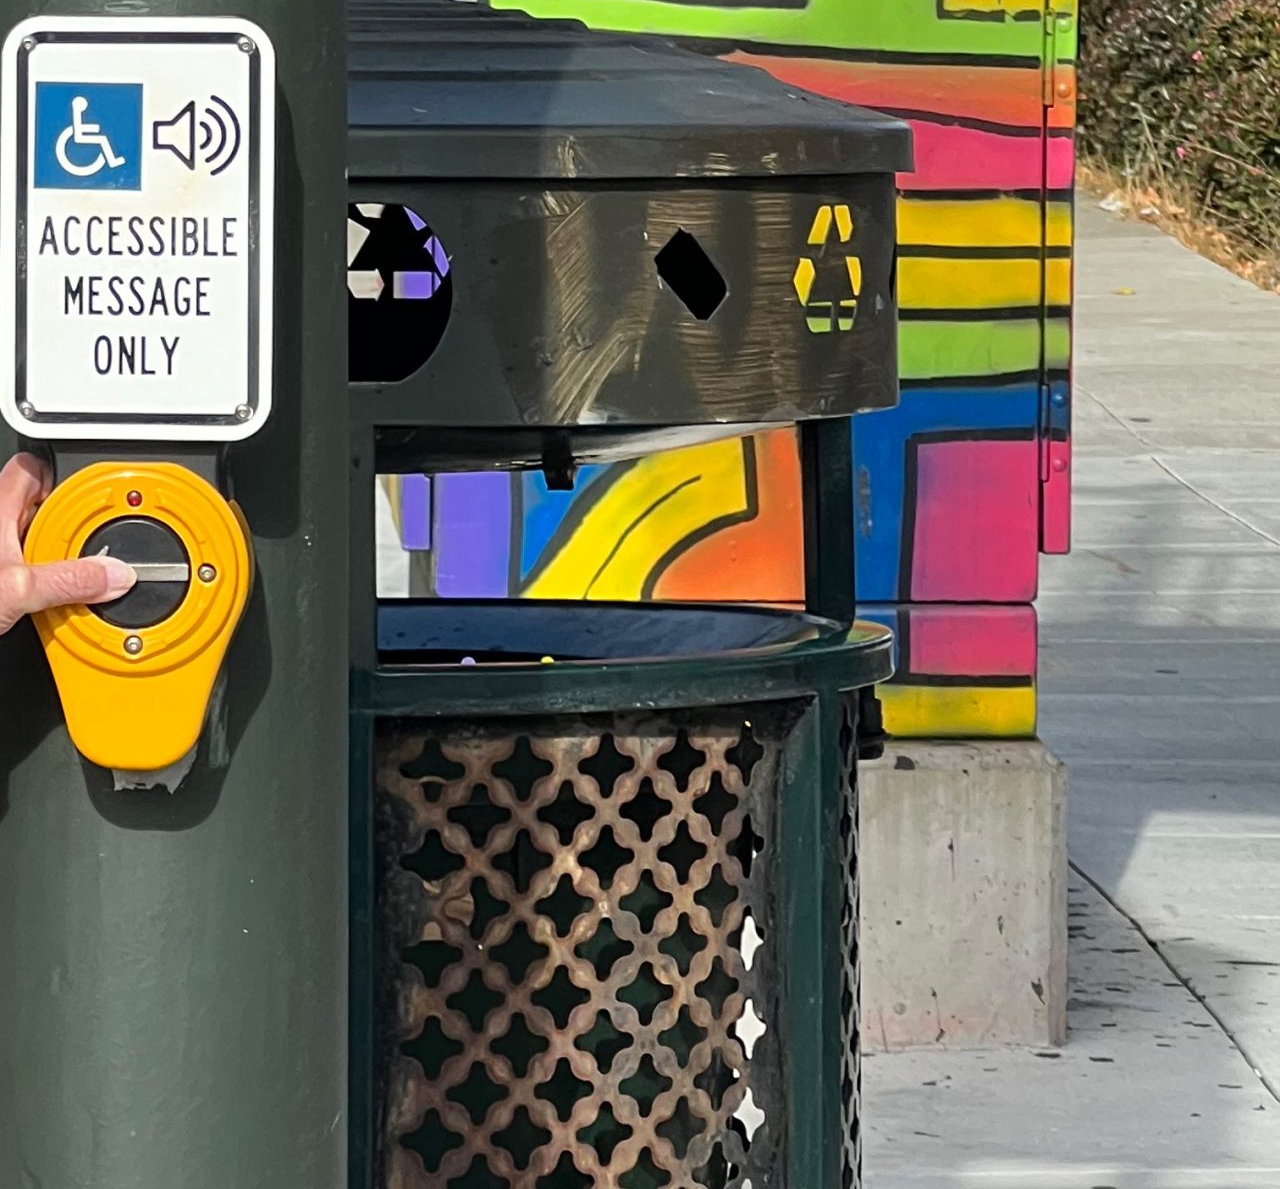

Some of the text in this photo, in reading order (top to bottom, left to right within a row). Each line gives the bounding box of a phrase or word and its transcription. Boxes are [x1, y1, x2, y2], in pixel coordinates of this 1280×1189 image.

[38, 215, 239, 257] ACCESSIBLE
[63, 276, 211, 317] MESSAGE
[94, 335, 181, 376] ONLY
